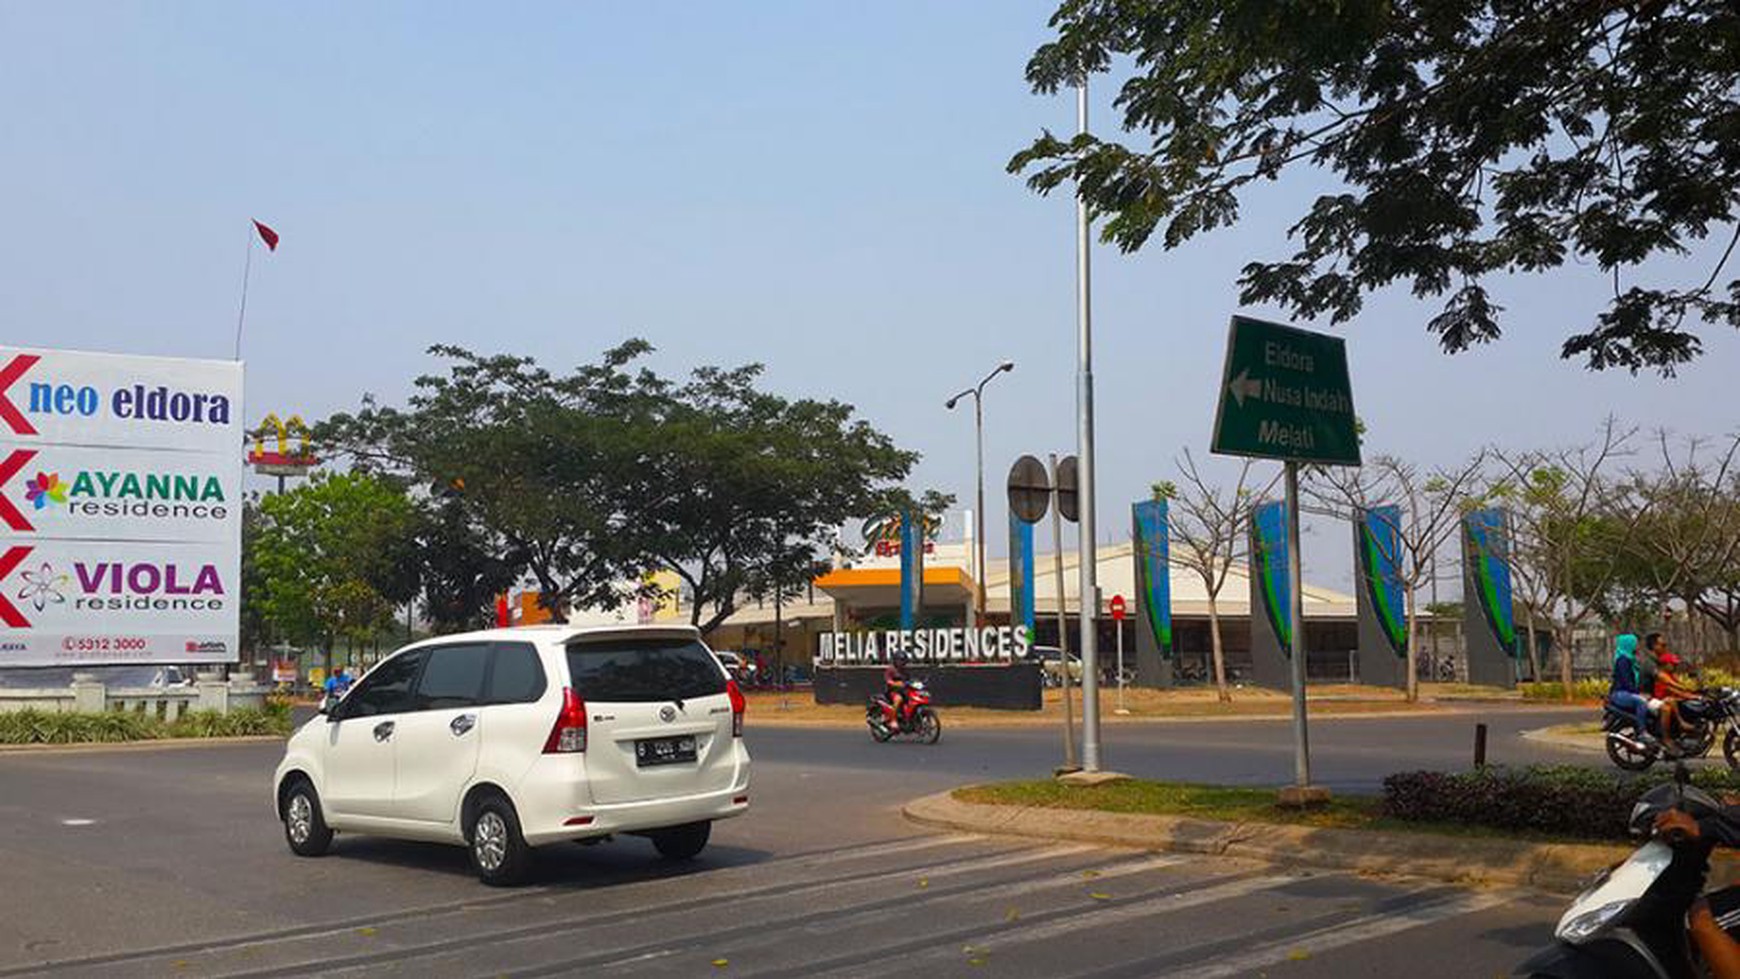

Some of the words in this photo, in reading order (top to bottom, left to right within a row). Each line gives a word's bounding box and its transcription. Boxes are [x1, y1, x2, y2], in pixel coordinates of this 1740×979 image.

[1264, 341, 1315, 372] Eldora
[29, 382, 99, 416] neo
[112, 385, 230, 424] eldora
[1263, 378, 1301, 407] Nusa
[1304, 386, 1350, 414] Indah
[1258, 420, 1315, 449] Melati
[69, 471, 225, 502] AYANNA
[69, 501, 227, 519] residence
[75, 563, 224, 595] VIOLA
[75, 595, 224, 611] residence
[113, 638, 146, 650] 3000
[820, 632, 879, 660] MELIA
[886, 625, 1029, 660] RESIDENCES
